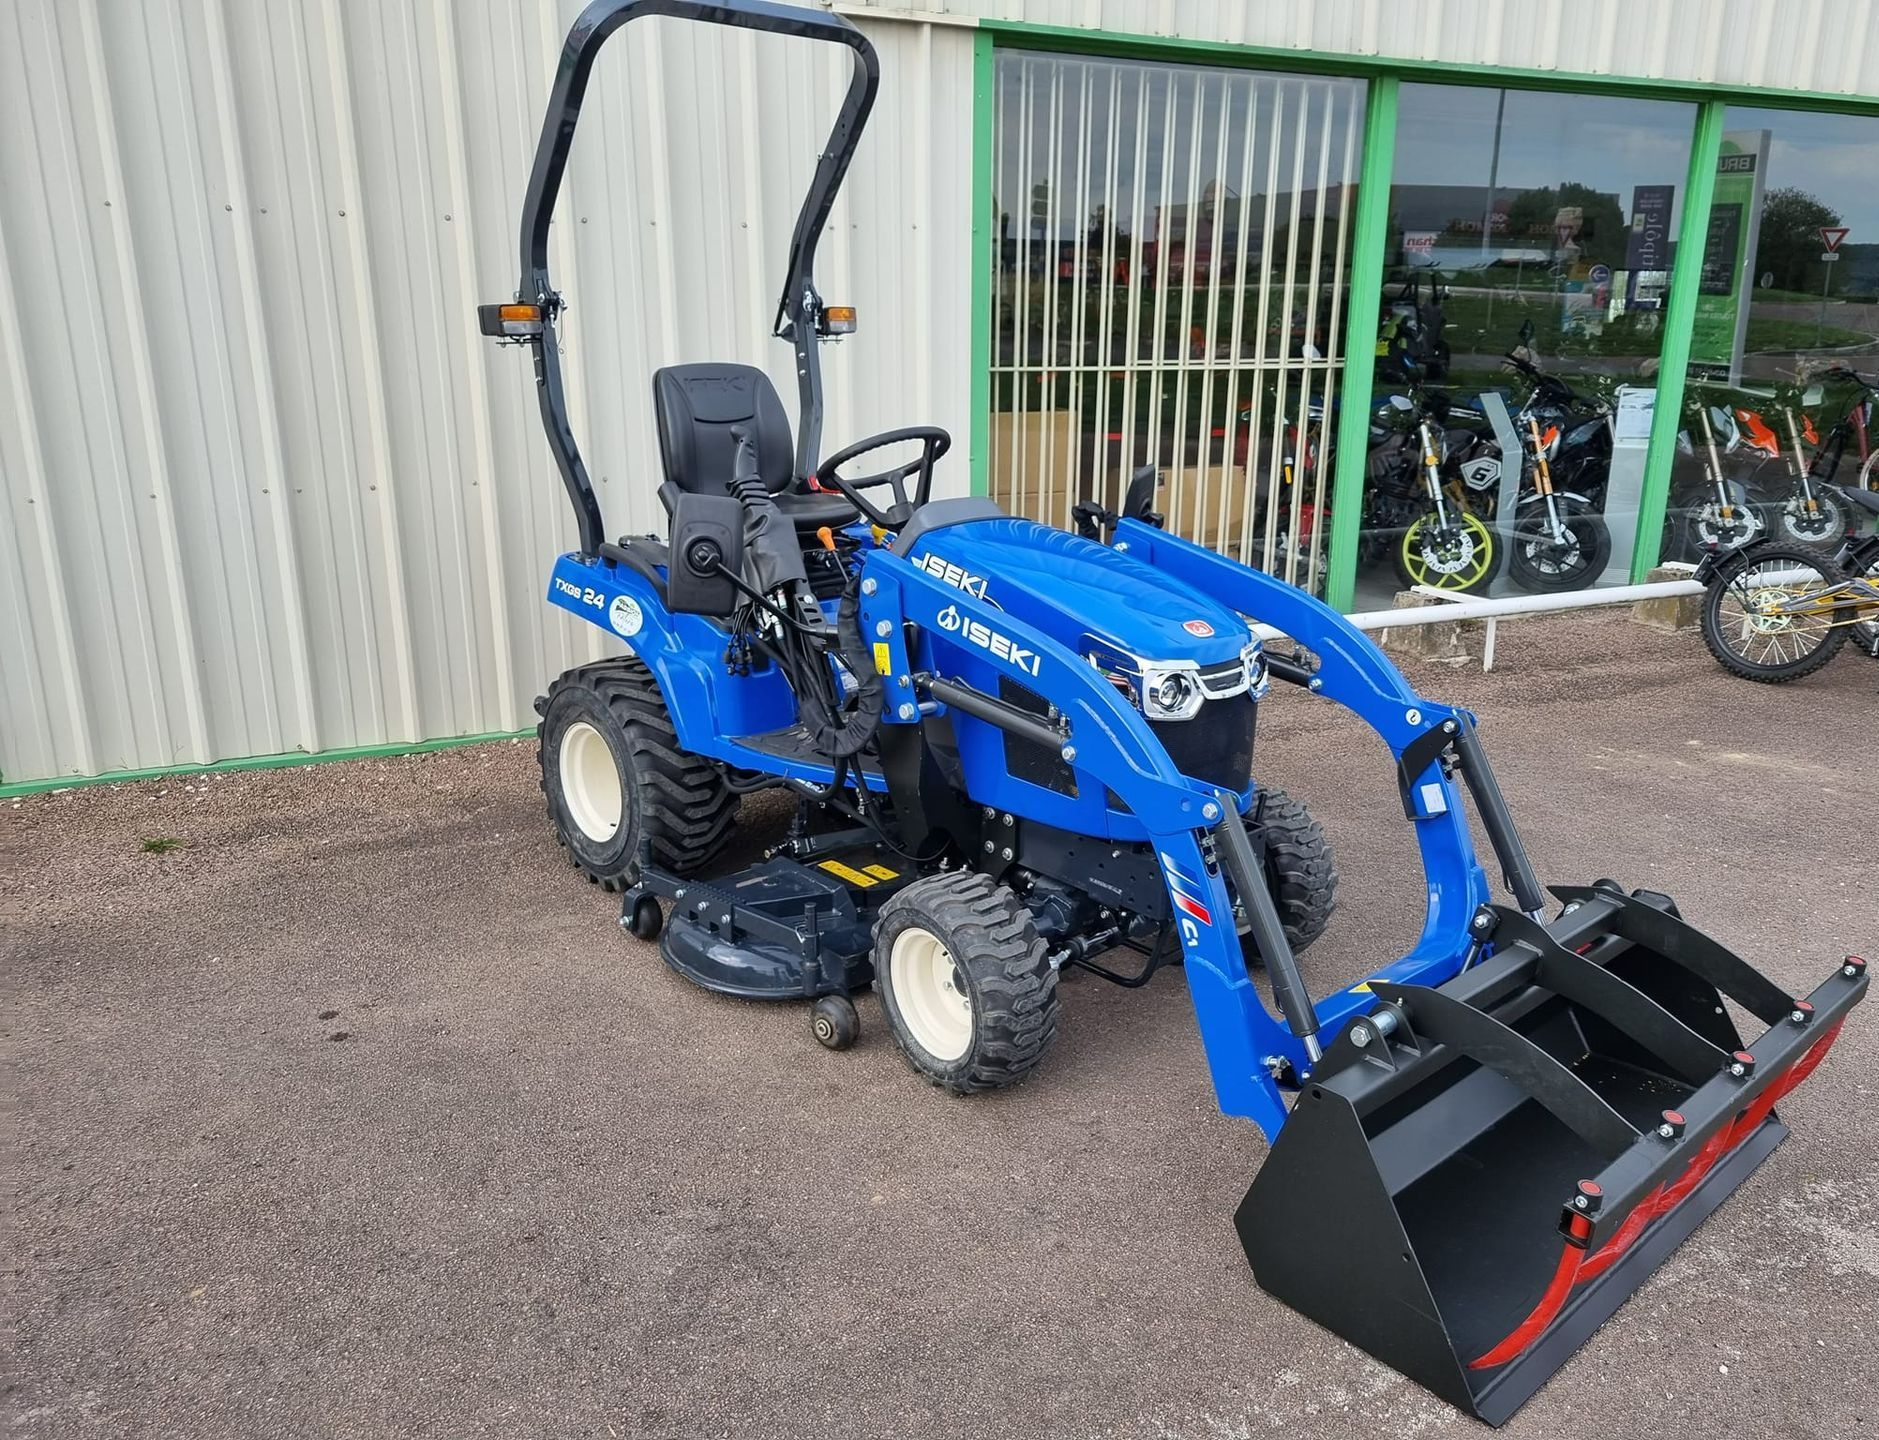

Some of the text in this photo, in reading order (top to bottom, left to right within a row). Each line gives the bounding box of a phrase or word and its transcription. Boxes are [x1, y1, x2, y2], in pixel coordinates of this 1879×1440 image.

[1470, 466, 1491, 482] 6
[920, 552, 988, 600] ISEKI
[555, 577, 605, 610] TXGS 24
[961, 616, 1041, 677] ISEKI
[1181, 918, 1199, 947] C1
